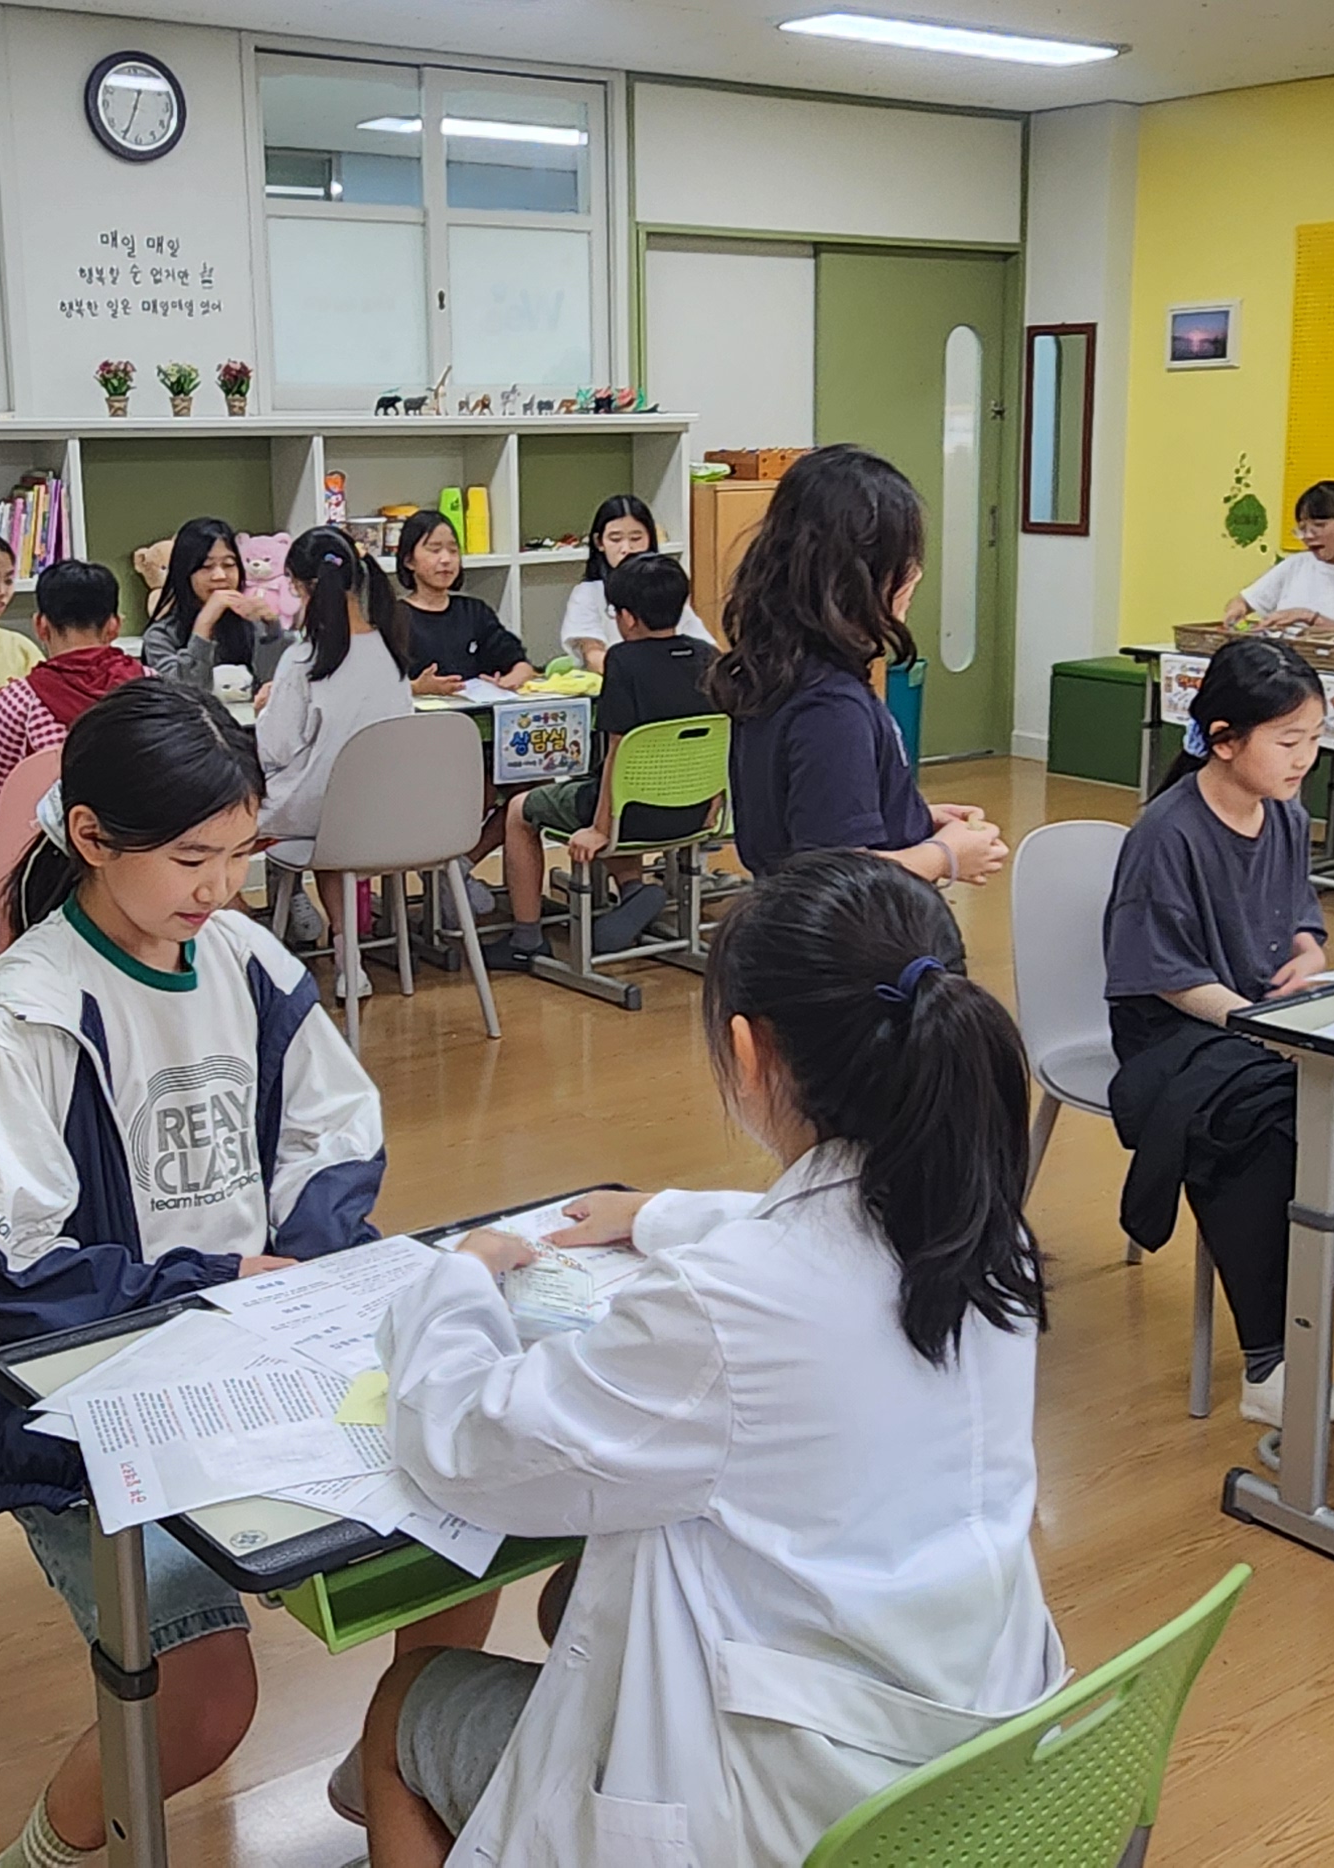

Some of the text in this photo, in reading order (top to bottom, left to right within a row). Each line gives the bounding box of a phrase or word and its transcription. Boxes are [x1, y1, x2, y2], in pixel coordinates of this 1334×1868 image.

[100, 230, 180, 258] 매일 매일
[79, 264, 190, 286] 행복할 순 없지만
[59, 298, 99, 319] 행복한
[107, 298, 132, 319] 일은
[510, 727, 567, 756] 상담실
[150, 1196, 192, 1212] team
